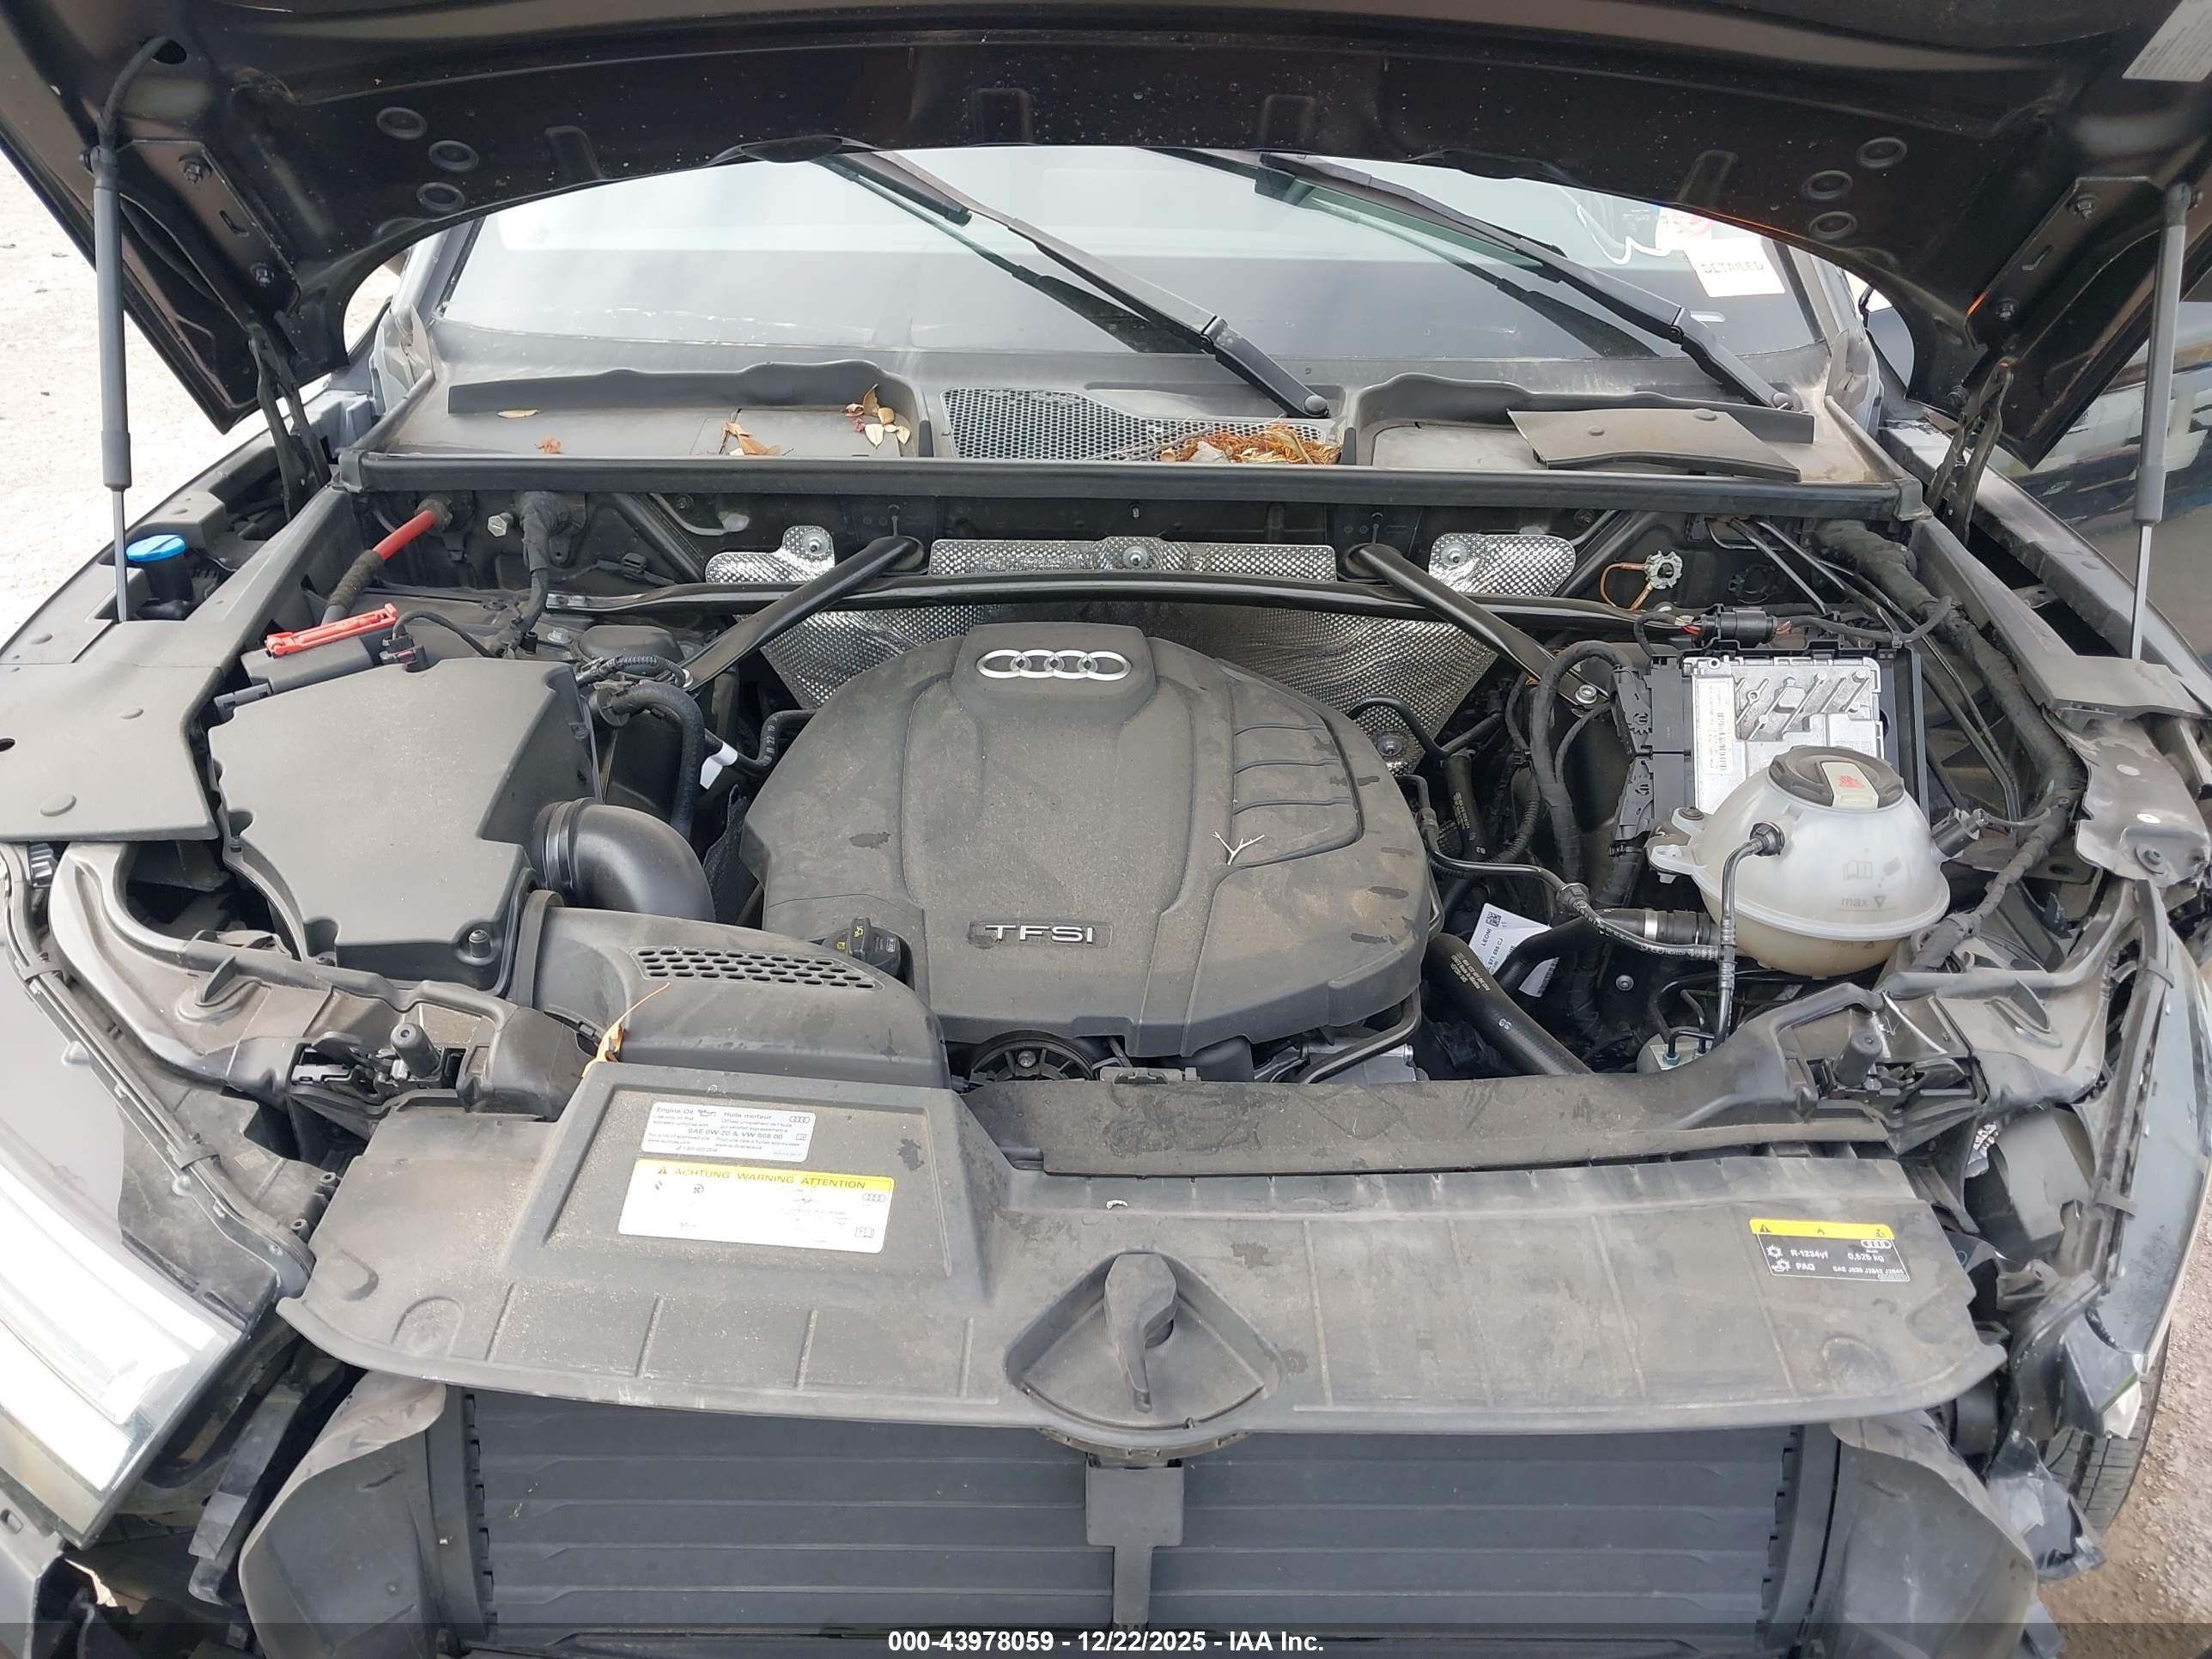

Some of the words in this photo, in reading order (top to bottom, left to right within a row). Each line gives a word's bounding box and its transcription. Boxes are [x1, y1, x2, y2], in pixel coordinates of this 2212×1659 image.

[1700, 261, 1765, 273] DETAILED
[1841, 898, 1869, 908] max
[985, 924, 1096, 945] TFSI
[657, 1106, 681, 1115] Engine
[674, 1169, 730, 1179] ACHTUNG
[738, 1173, 794, 1183] WARNING
[800, 1177, 866, 1188] ATTENTION
